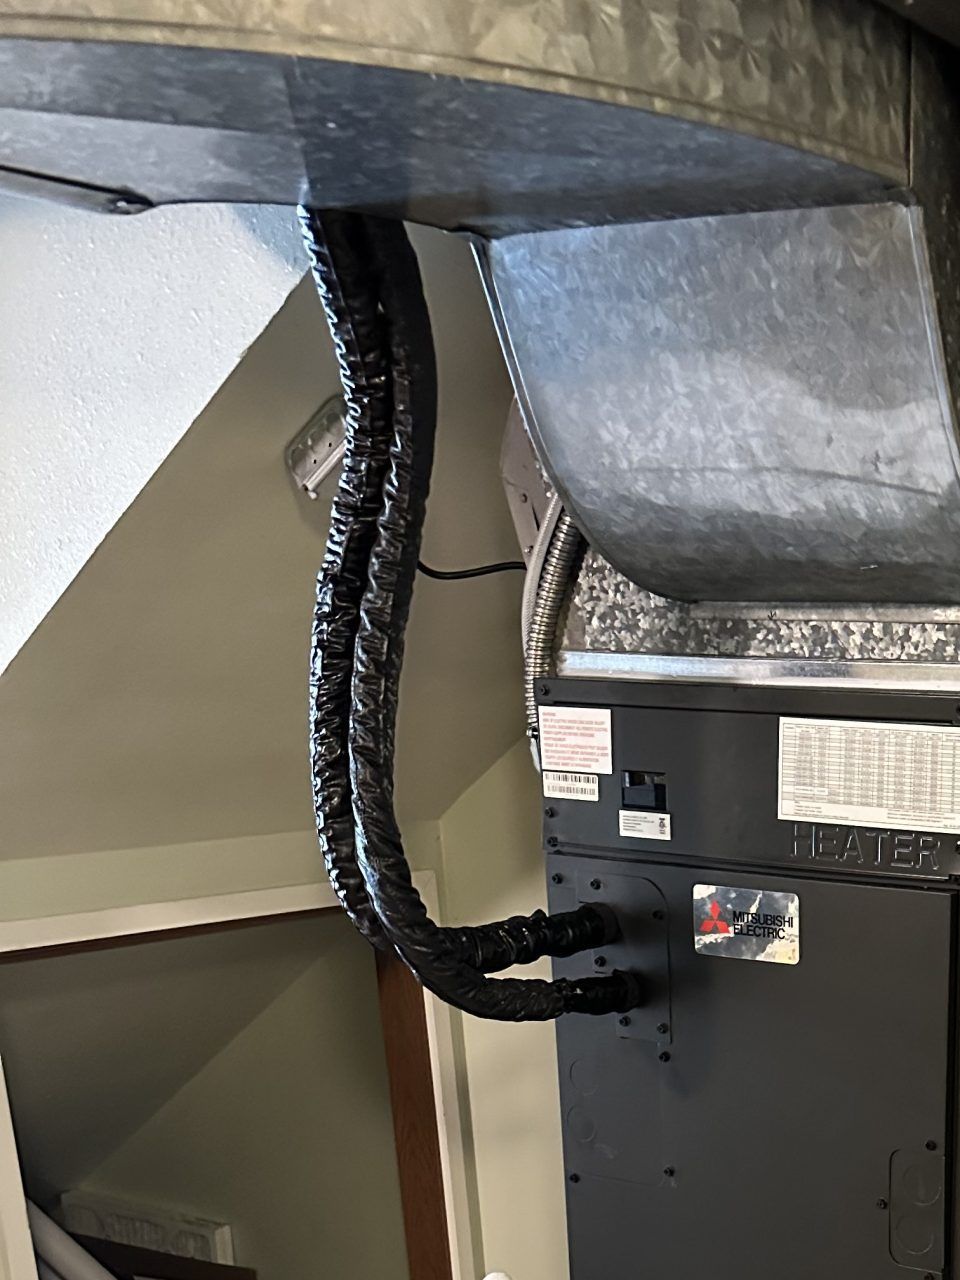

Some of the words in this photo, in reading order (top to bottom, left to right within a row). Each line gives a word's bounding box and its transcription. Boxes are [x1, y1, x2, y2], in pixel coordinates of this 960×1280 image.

[790, 824, 939, 871] HEATER
[733, 910, 794, 928] MITSUBISHI
[733, 924, 786, 940] ELECTRIC
